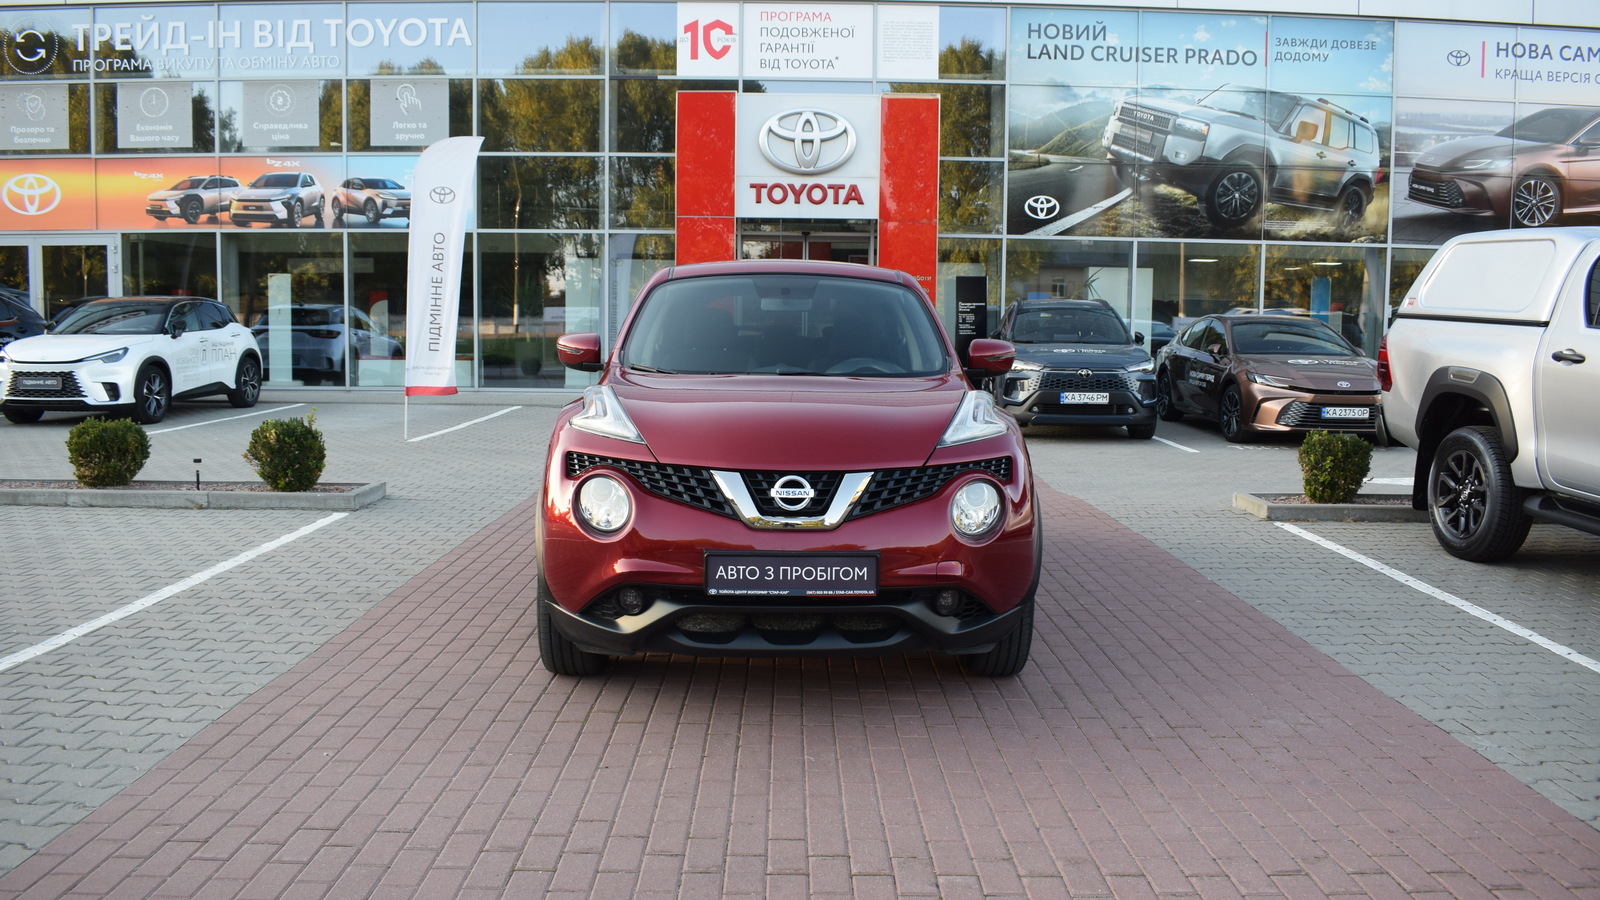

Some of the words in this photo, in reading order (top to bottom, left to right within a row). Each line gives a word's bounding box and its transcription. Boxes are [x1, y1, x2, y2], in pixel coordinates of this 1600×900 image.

[760, 11, 832, 22] ПРОГРАМА
[71, 14, 241, 56] ТРЕЙД-ІН
[254, 18, 315, 54] ВІД
[323, 17, 473, 47] TOYOTA
[760, 25, 856, 39] ПОДОВЖЕНОЇ
[1027, 20, 1107, 41] НОВИЙ
[760, 40, 816, 53] ГАРАНТІЇ
[1275, 37, 1328, 49] ЗАВЖДИ
[1331, 39, 1377, 51] ДОВЕЗЕ
[1496, 41, 1553, 61] НОВА
[1027, 43, 1085, 61] LAND
[1091, 45, 1179, 64] CRUISER
[1185, 48, 1258, 66] PRADO
[1274, 51, 1330, 63] ДОДОМУ
[73, 58, 153, 72] ПРОГРАМА
[157, 57, 214, 71] ВИКУПУ
[218, 56, 235, 69] ТА
[238, 56, 299, 70] ОБМІНУ
[302, 55, 340, 68] АВТО
[760, 59, 781, 71] ВІД
[1495, 68, 1543, 83] КРАЩА
[1547, 71, 1591, 84] ВЕРСІЯ
[10, 126, 45, 135] Прозоро
[136, 123, 173, 131] Економія
[253, 122, 308, 130] Справедлива
[14, 135, 51, 144] безпечно
[161, 135, 180, 143] часу
[272, 133, 290, 141] ціна
[749, 183, 865, 205] TOYOTA
[432, 232, 446, 273] АВТО
[428, 276, 443, 352] ПІДМІННЕ
[715, 565, 760, 580] АВТО
[764, 566, 775, 580] З
[779, 566, 868, 581] ПРОБІГОМ
